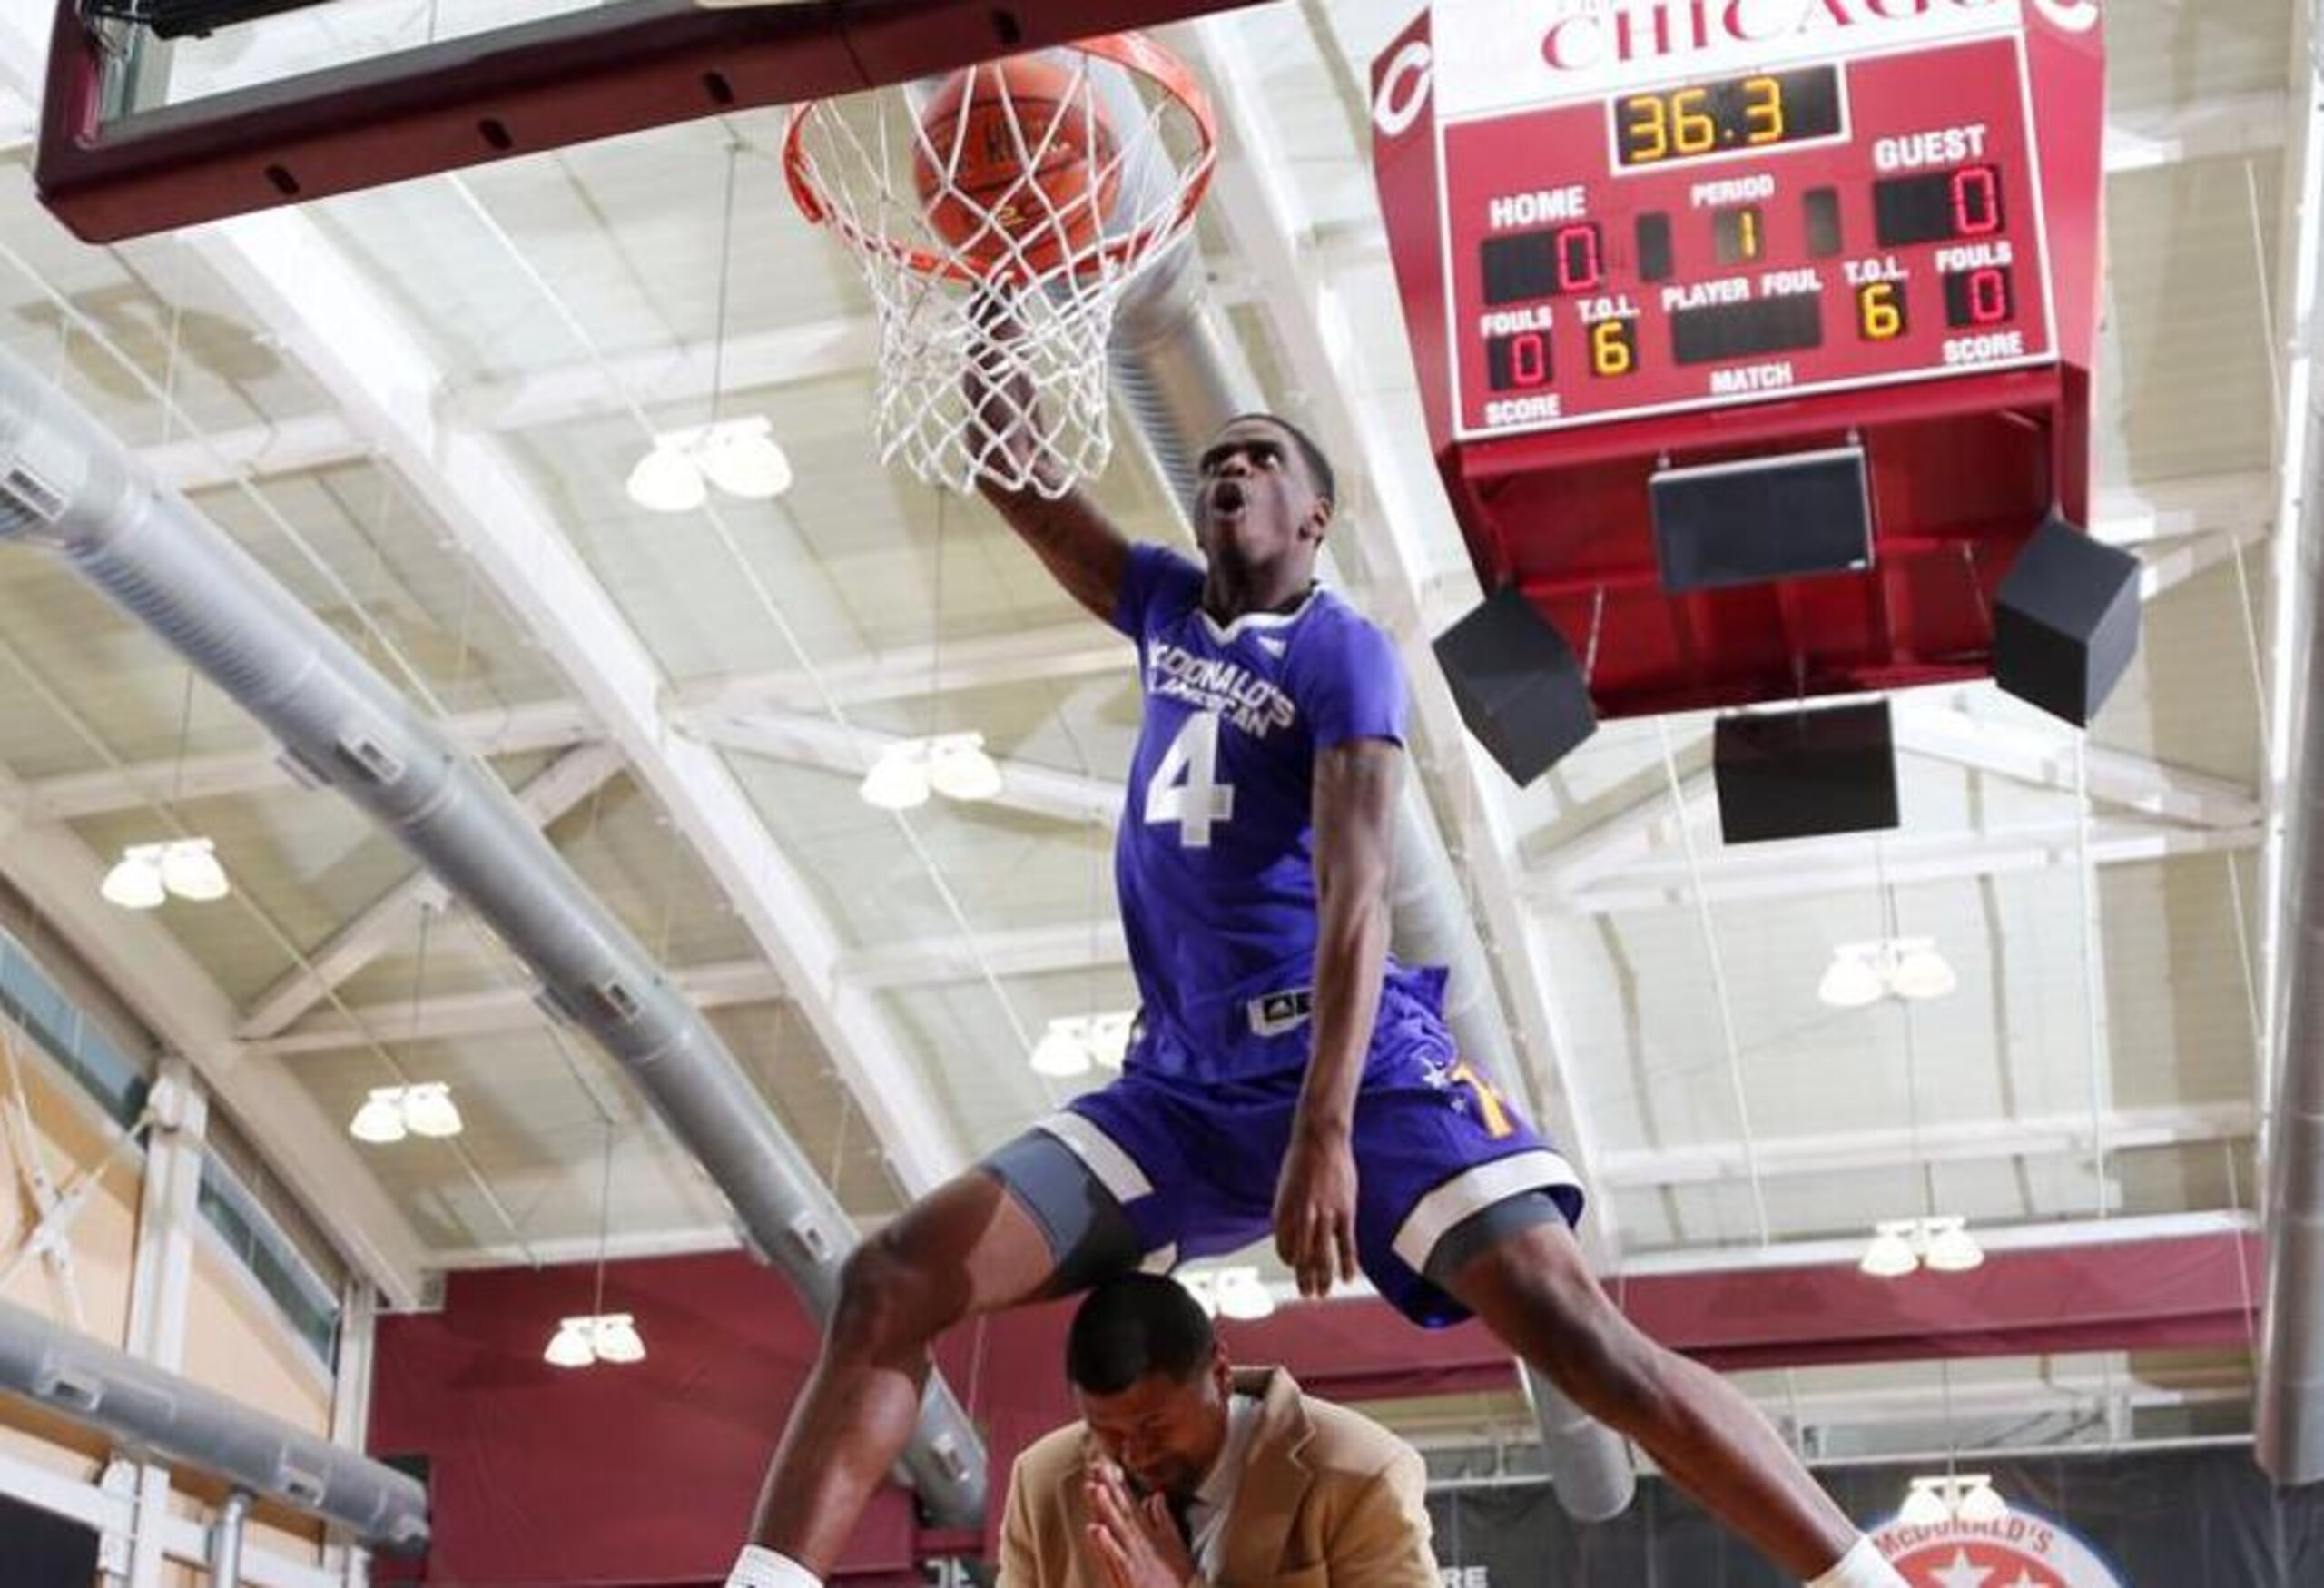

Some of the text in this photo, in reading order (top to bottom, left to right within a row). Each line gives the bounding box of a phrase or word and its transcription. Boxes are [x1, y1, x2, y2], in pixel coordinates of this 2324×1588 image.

[1541, 0, 2004, 71] CHICA
[1629, 76, 1782, 161] 36.3
[1874, 124, 1986, 171] GUEST
[1490, 185, 1586, 228] HOME
[1691, 173, 1776, 209] PERIOD
[1954, 167, 1998, 233] 0
[1558, 226, 1599, 291] 0
[1844, 255, 1909, 285] T.O.L.
[1935, 241, 2013, 273] FOULS
[1577, 294, 1640, 324] T.O.L.
[1662, 269, 1823, 312] PLAYER FOUL
[1863, 283, 1900, 339] 6
[1970, 269, 2005, 323] 0
[1481, 306, 1552, 339] FOULS
[1512, 332, 1544, 384] 0
[1595, 321, 1630, 378] 6
[1943, 331, 2023, 364] SCORE
[1710, 361, 1794, 395] MATCH
[1485, 394, 1560, 424] SCORE
[1148, 637, 1296, 728] DONALD'S
[1143, 710, 1235, 847] 4
